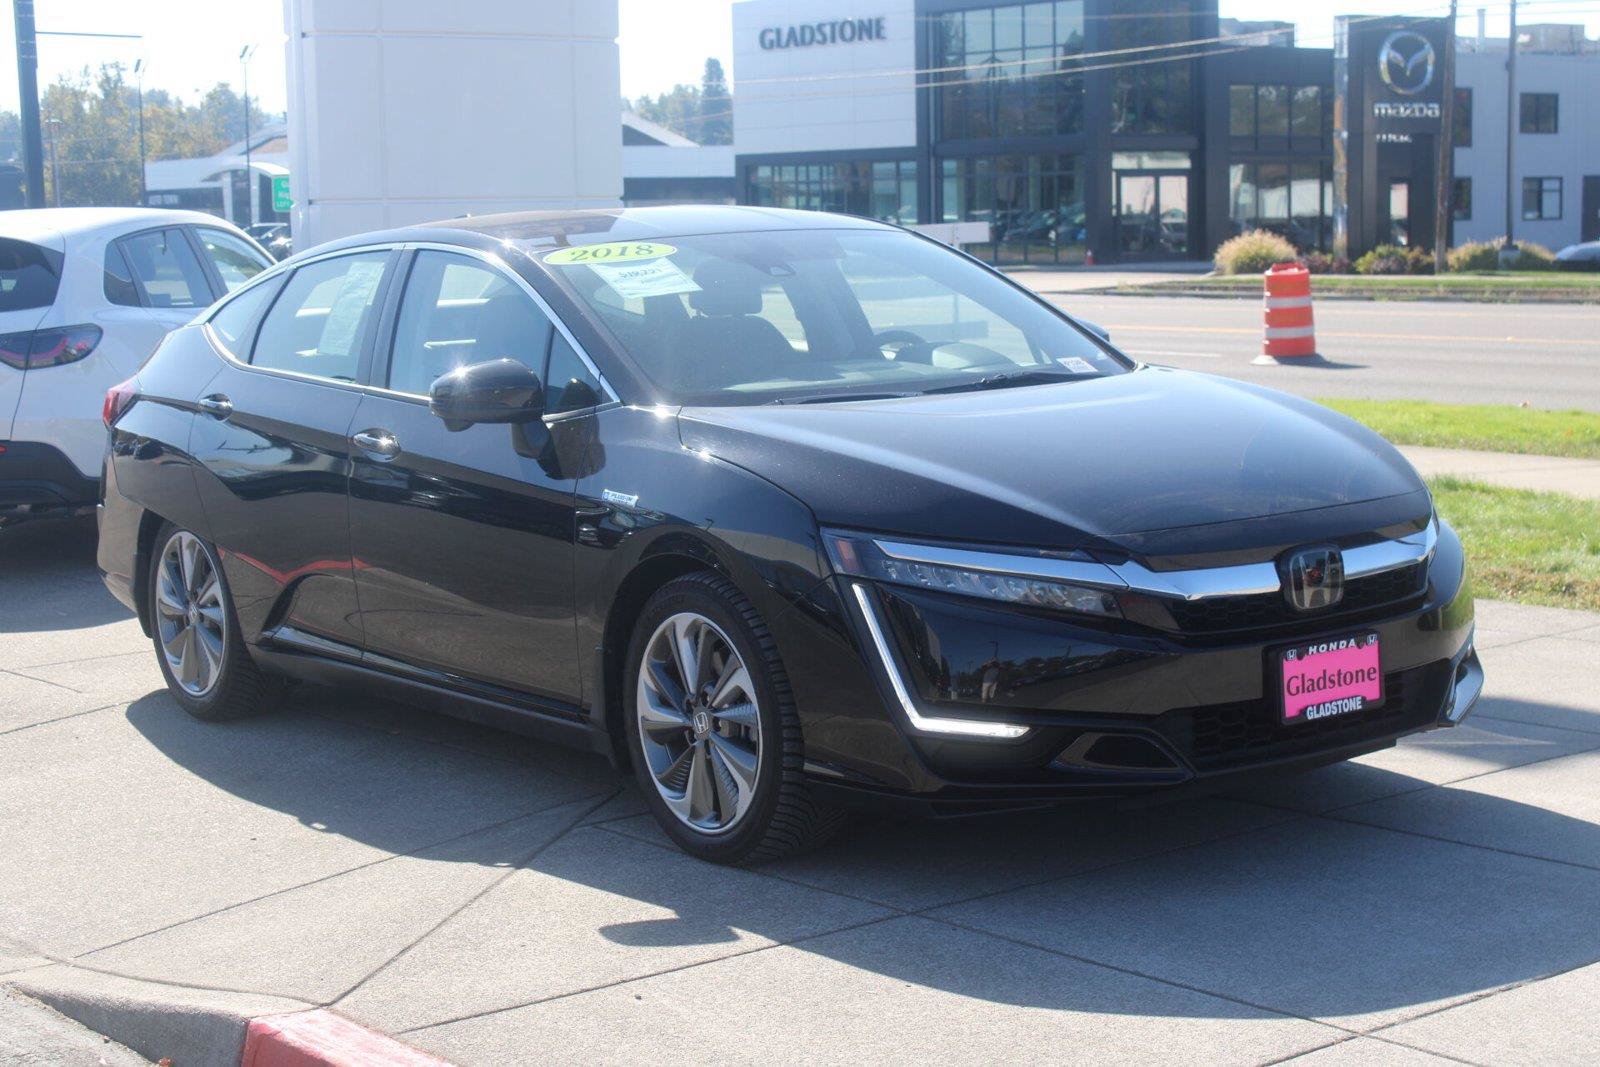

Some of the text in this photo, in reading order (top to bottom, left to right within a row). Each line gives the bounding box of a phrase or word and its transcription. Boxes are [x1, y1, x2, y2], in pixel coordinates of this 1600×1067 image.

[759, 16, 887, 50] GLADSTONE
[570, 245, 653, 262] 2018
[1308, 638, 1356, 655] HONDA
[1286, 666, 1377, 696] Gladstone
[1306, 696, 1362, 720] GLADSTONE
